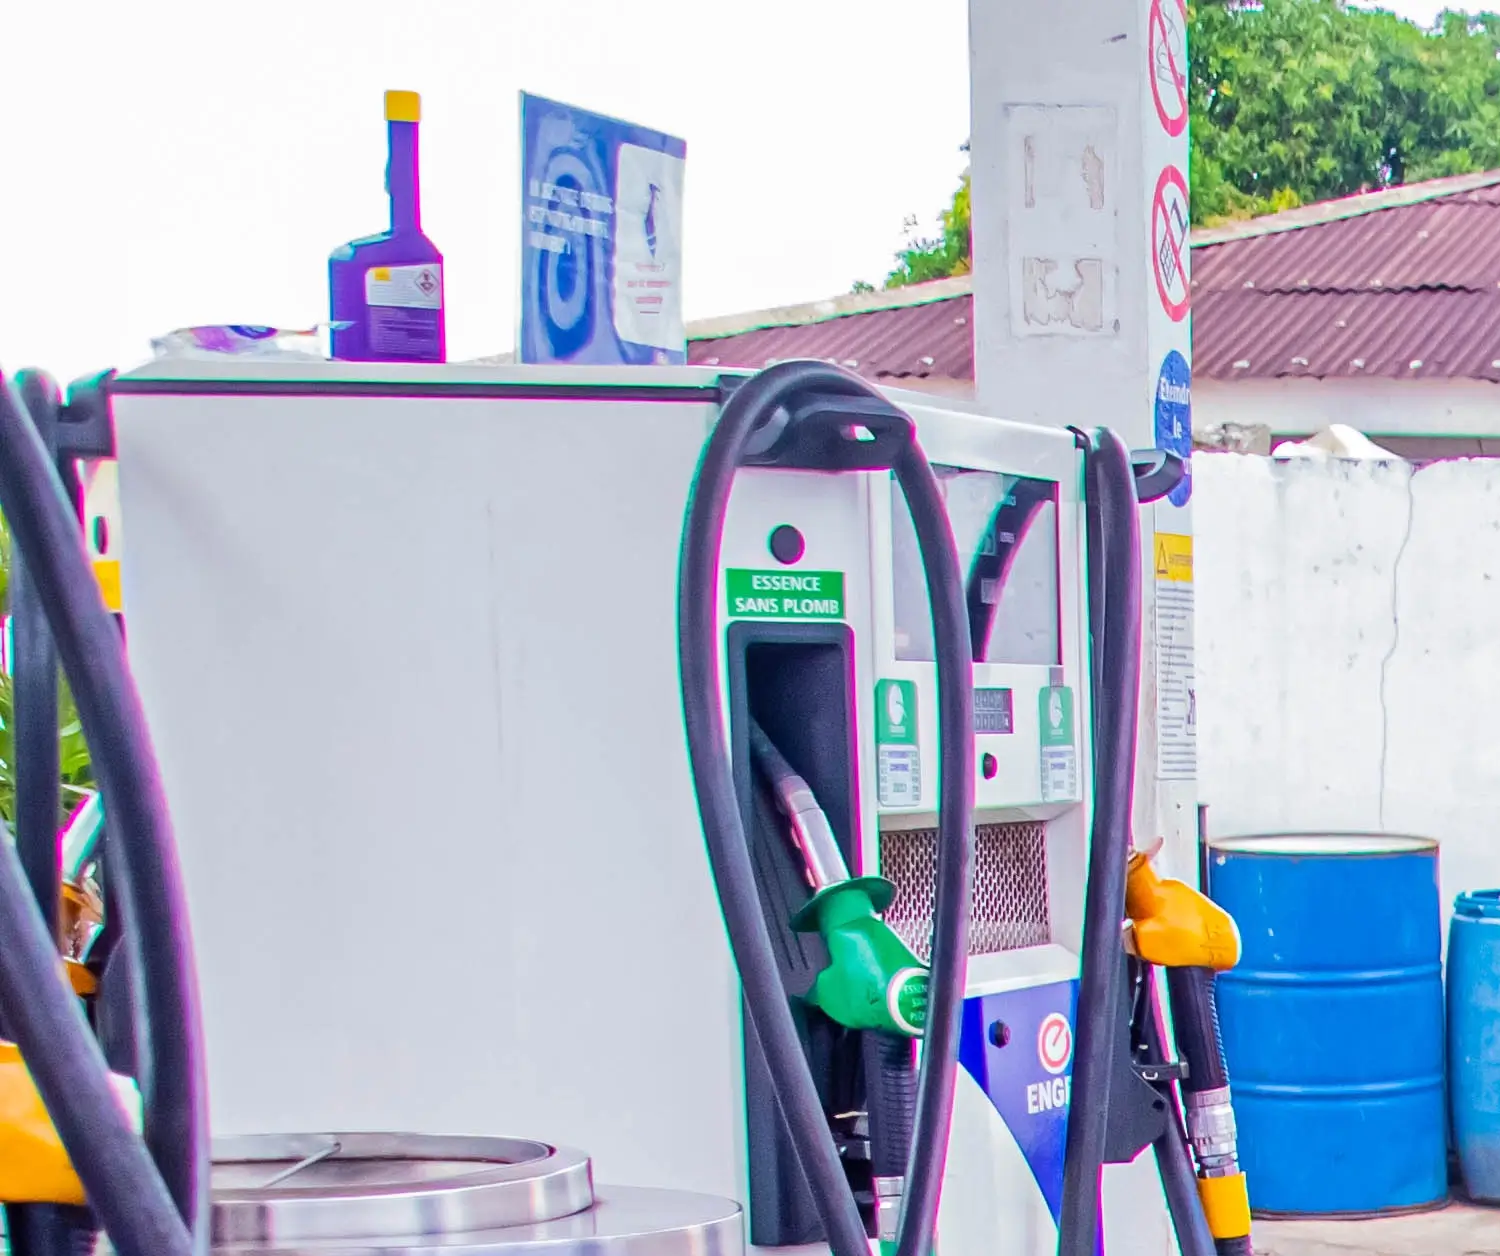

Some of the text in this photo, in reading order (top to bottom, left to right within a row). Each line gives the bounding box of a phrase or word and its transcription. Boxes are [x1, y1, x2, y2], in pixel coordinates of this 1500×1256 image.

[751, 574, 821, 591] ESSENCE
[735, 598, 840, 615] SANS PLOMB
